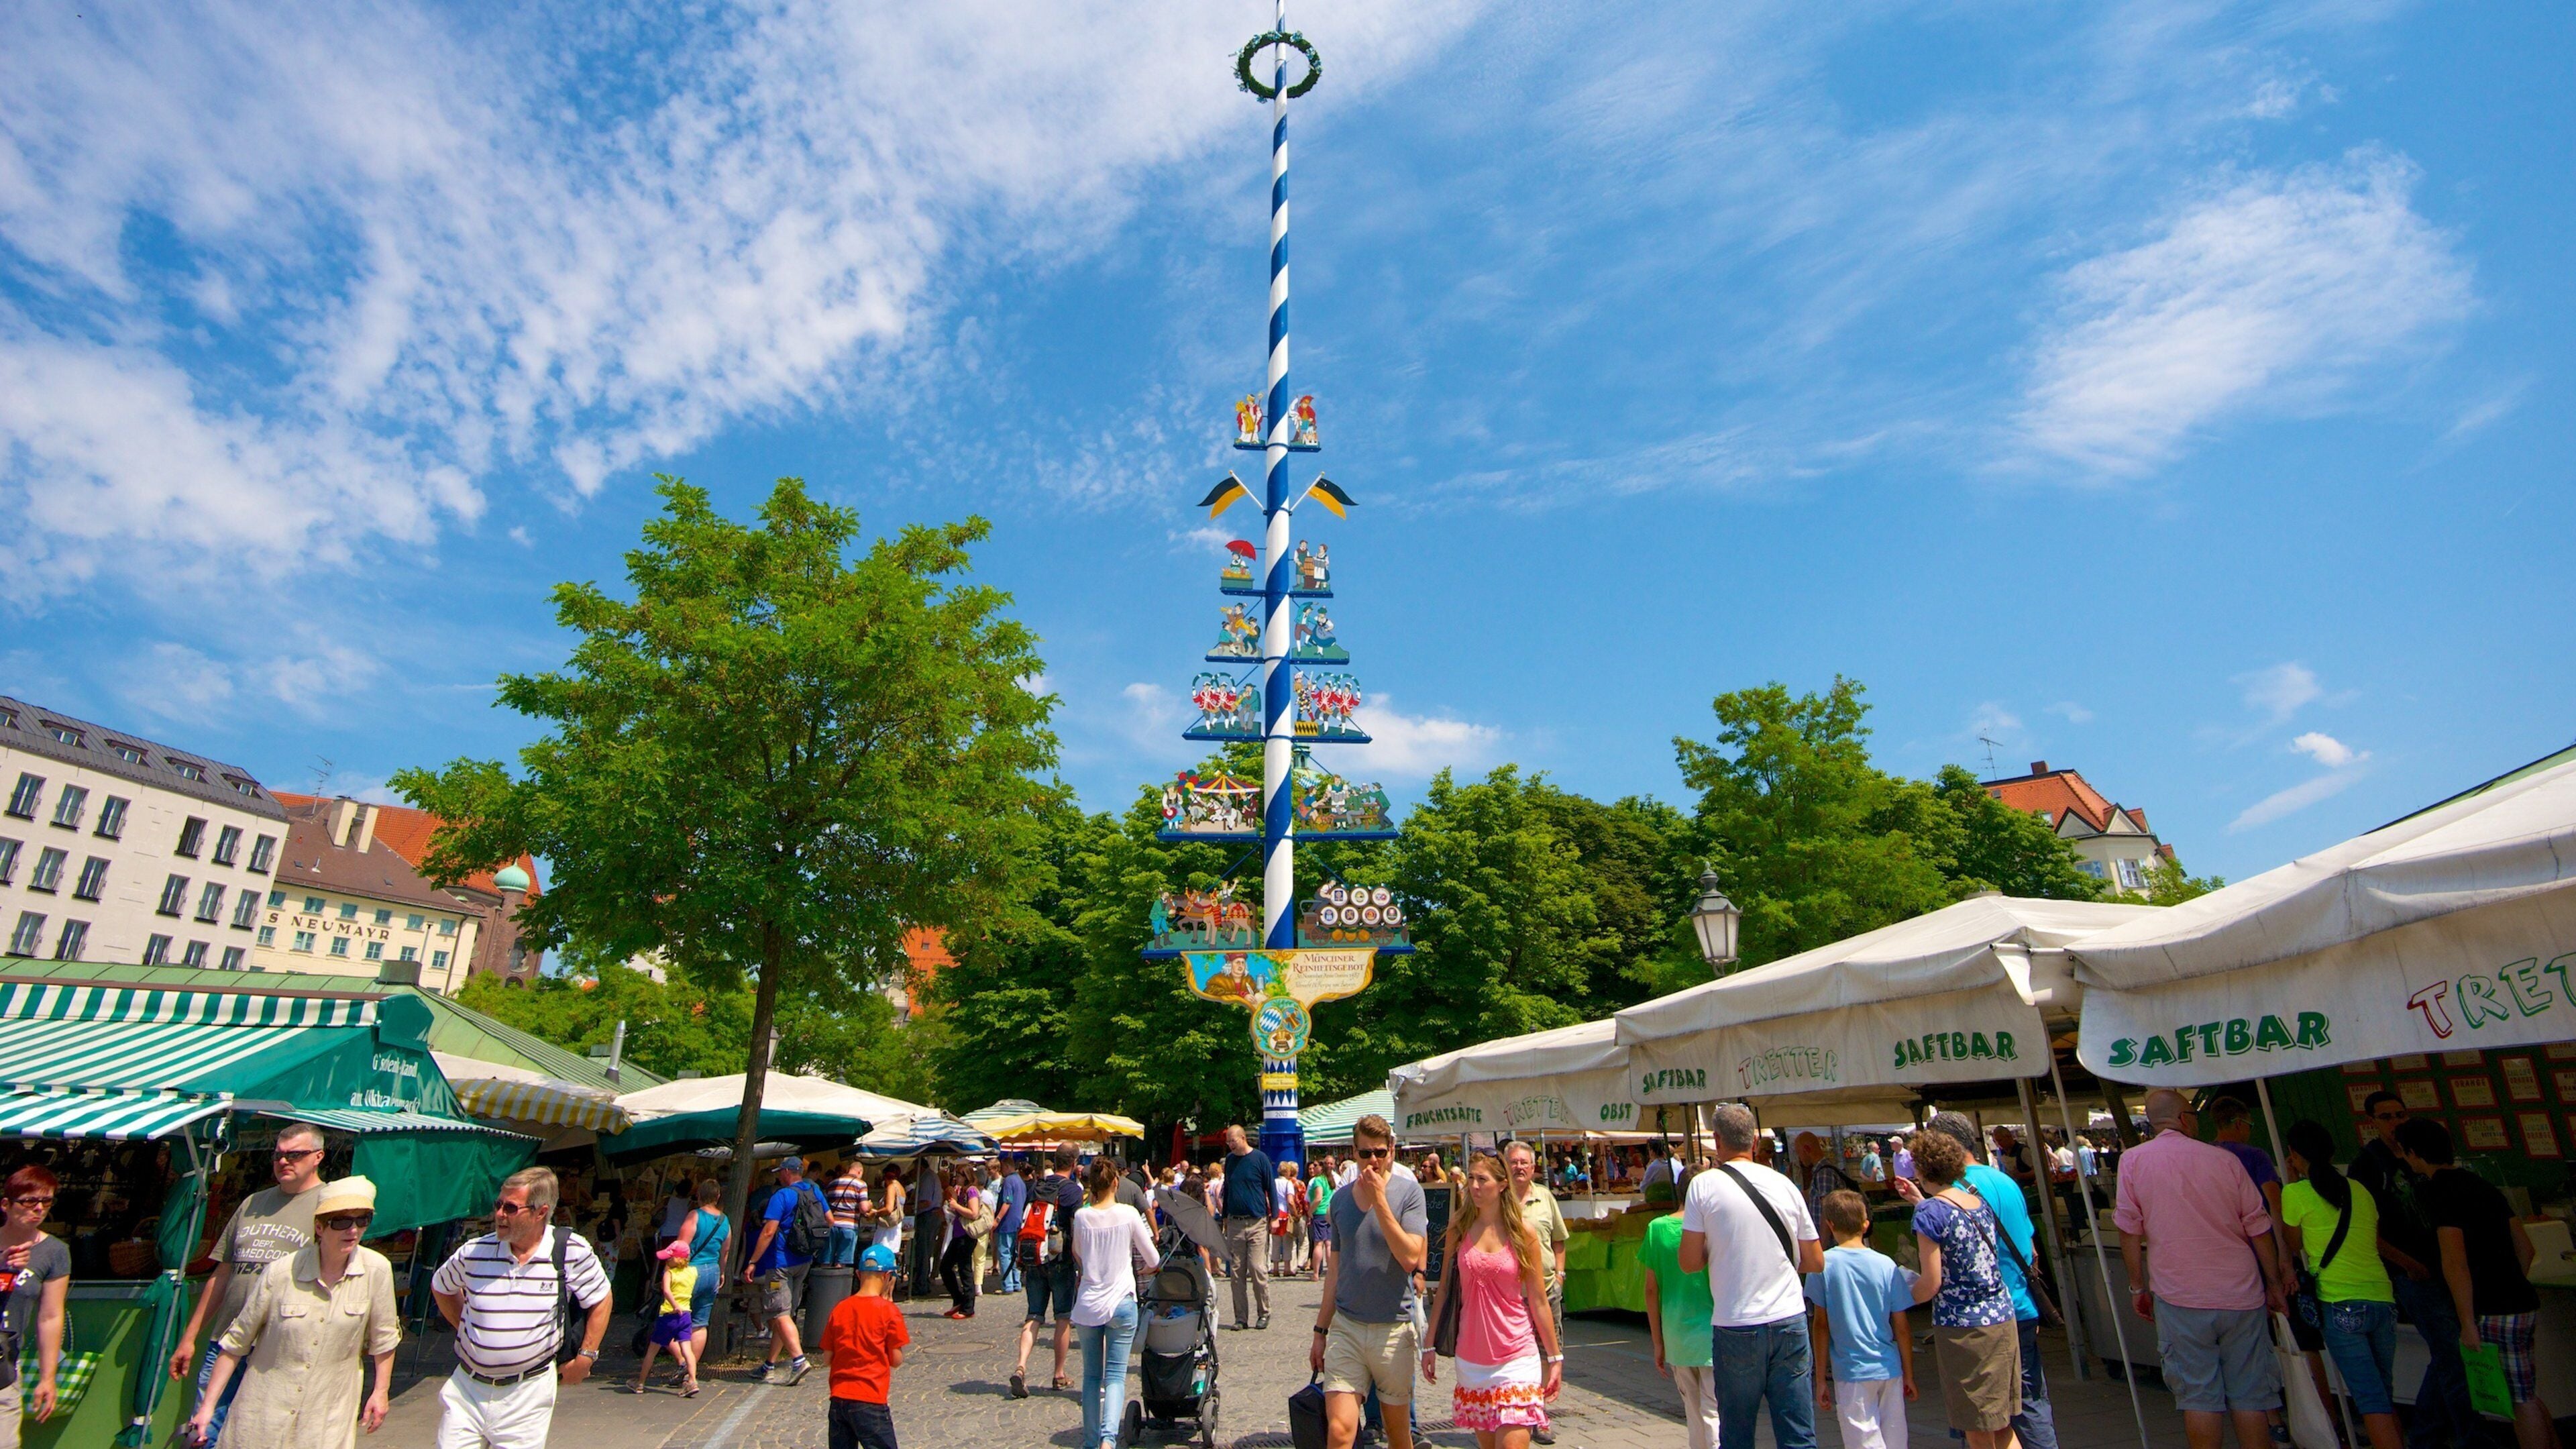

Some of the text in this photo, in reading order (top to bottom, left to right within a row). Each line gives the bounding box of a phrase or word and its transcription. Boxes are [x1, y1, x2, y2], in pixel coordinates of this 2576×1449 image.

[291, 916, 390, 940] NEUMAYR
[2107, 1011, 2330, 1068] SAFTBAR
[1643, 1031, 2018, 1095] SAFTBAR TRETTER SAFTBAR
[2455, 1079, 2486, 1088] ORANGE
[1406, 1095, 1632, 1130] FRUCHTSÄFTE TRETTER OBST
[237, 1223, 311, 1248] OUTHERN
[252, 1238, 276, 1248] DEPT.
